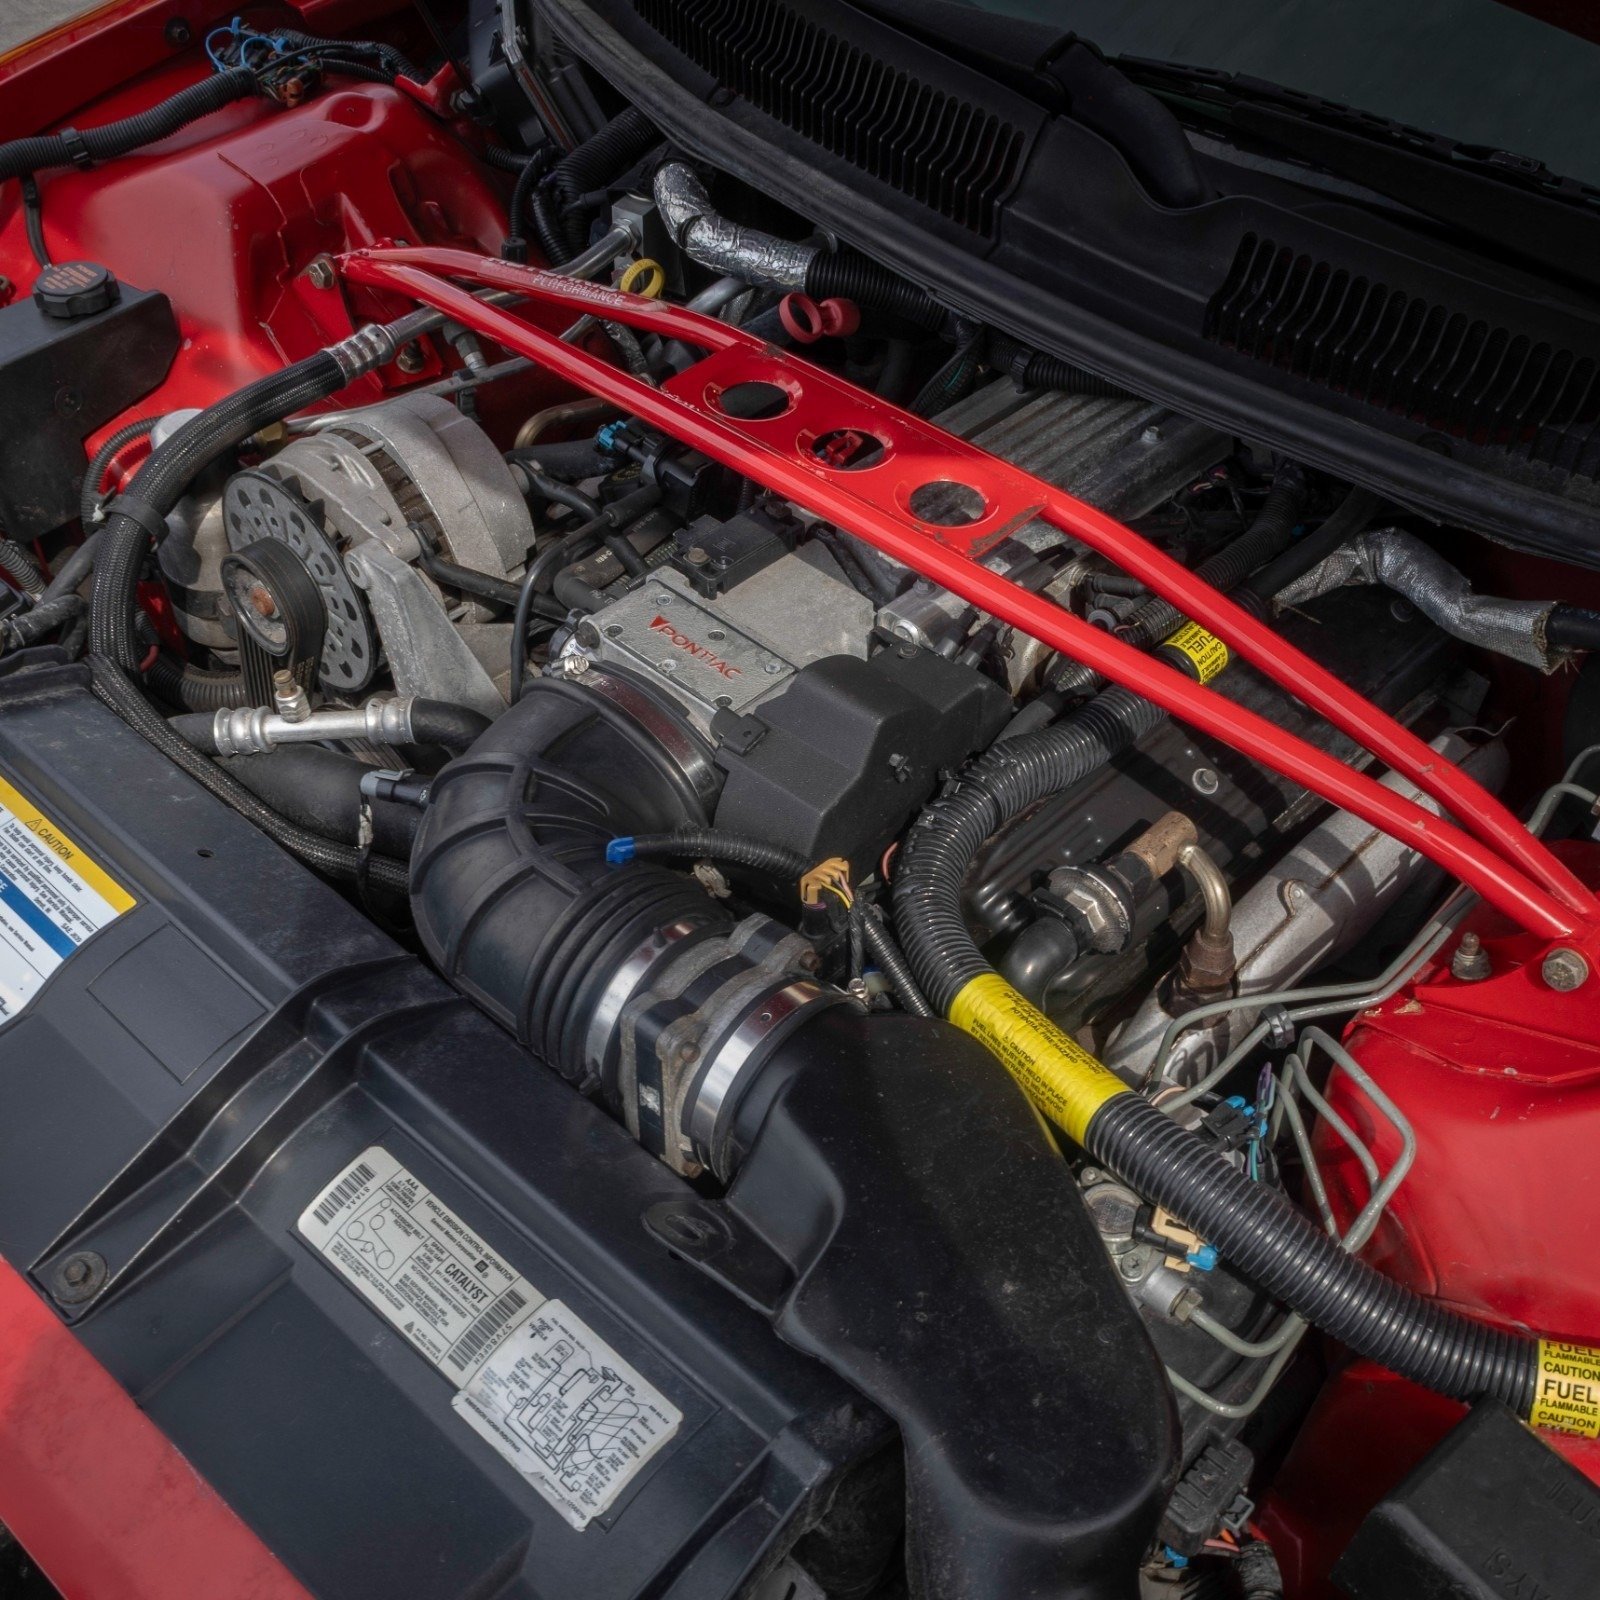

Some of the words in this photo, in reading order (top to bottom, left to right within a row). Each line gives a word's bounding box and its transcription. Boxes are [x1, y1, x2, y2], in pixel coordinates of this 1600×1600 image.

[533, 275, 626, 305] PERFORMANCE
[659, 625, 744, 680] PONTIAC
[1197, 642, 1222, 665] CAUTION
[29, 842, 44, 857] personal
[38, 828, 74, 860] CAUTION
[46, 898, 59, 910] Service
[61, 922, 71, 933] SAE
[1011, 1005, 1040, 1032] POTENTIAL
[1040, 1030, 1052, 1043] FIRE
[1052, 1041, 1077, 1064] HAZARD
[972, 1018, 988, 1033] FUEL
[986, 1031, 1003, 1047] LINES
[1001, 1045, 1017, 1060] MUST
[1025, 1067, 1041, 1082] HELD
[1047, 1086, 1068, 1106] PLACE
[1009, 1041, 1035, 1065] CAUTION
[405, 1177, 418, 1189] AAA
[425, 1199, 444, 1217] VEHICLE
[442, 1215, 464, 1235] EMISSION
[462, 1233, 485, 1254] CONTROL
[482, 1252, 514, 1281] INFORMATION
[444, 1262, 488, 1304] CATALYST
[528, 1322, 547, 1340] VEHICLE
[537, 1317, 553, 1332] FRONT
[1544, 1362, 1600, 1381] CAUTION
[1544, 1379, 1598, 1405] FUEL
[1540, 1398, 1598, 1416] FLAMMABLE
[465, 1397, 487, 1419] EMISSION
[499, 1431, 520, 1452] ROUTING
[1538, 1411, 1596, 1429] CAUTION
